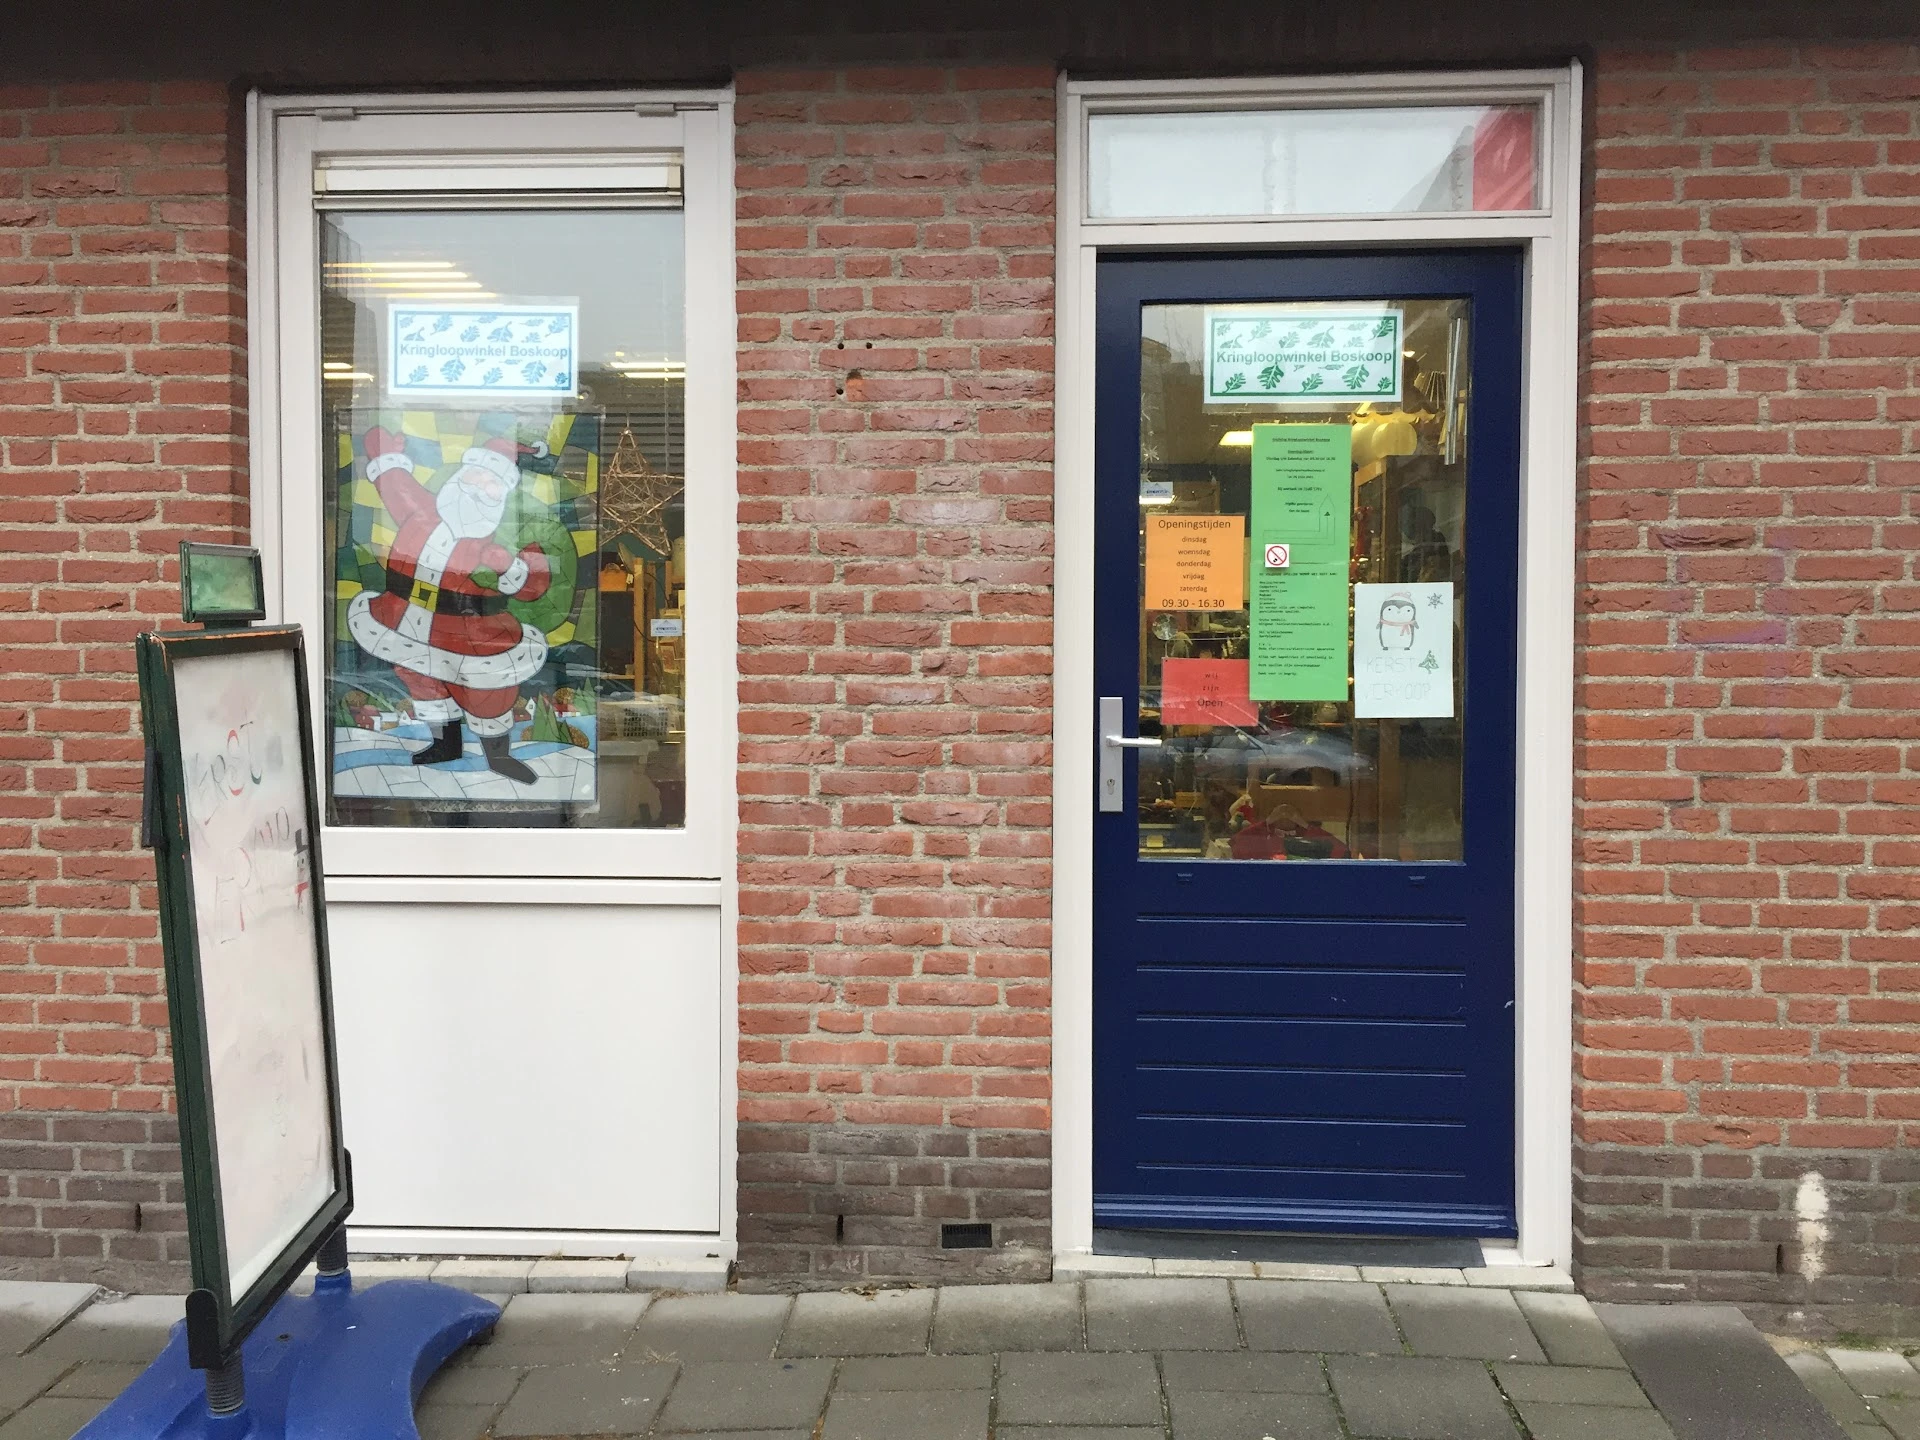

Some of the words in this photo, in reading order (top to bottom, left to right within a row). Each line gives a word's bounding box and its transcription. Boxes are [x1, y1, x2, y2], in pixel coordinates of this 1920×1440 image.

[400, 344, 506, 358] Kringloopwinkel
[510, 345, 568, 359] Boskoop
[1216, 351, 1326, 365] Kringloopwinkel
[1330, 350, 1393, 364] Boskoop
[1158, 519, 1231, 530] Openingstijden
[1176, 560, 1212, 568] donderdag
[1161, 598, 1189, 608] 09.30
[1198, 598, 1225, 608] 16.30
[1366, 656, 1417, 674] KERST
[1197, 698, 1223, 709] Open
